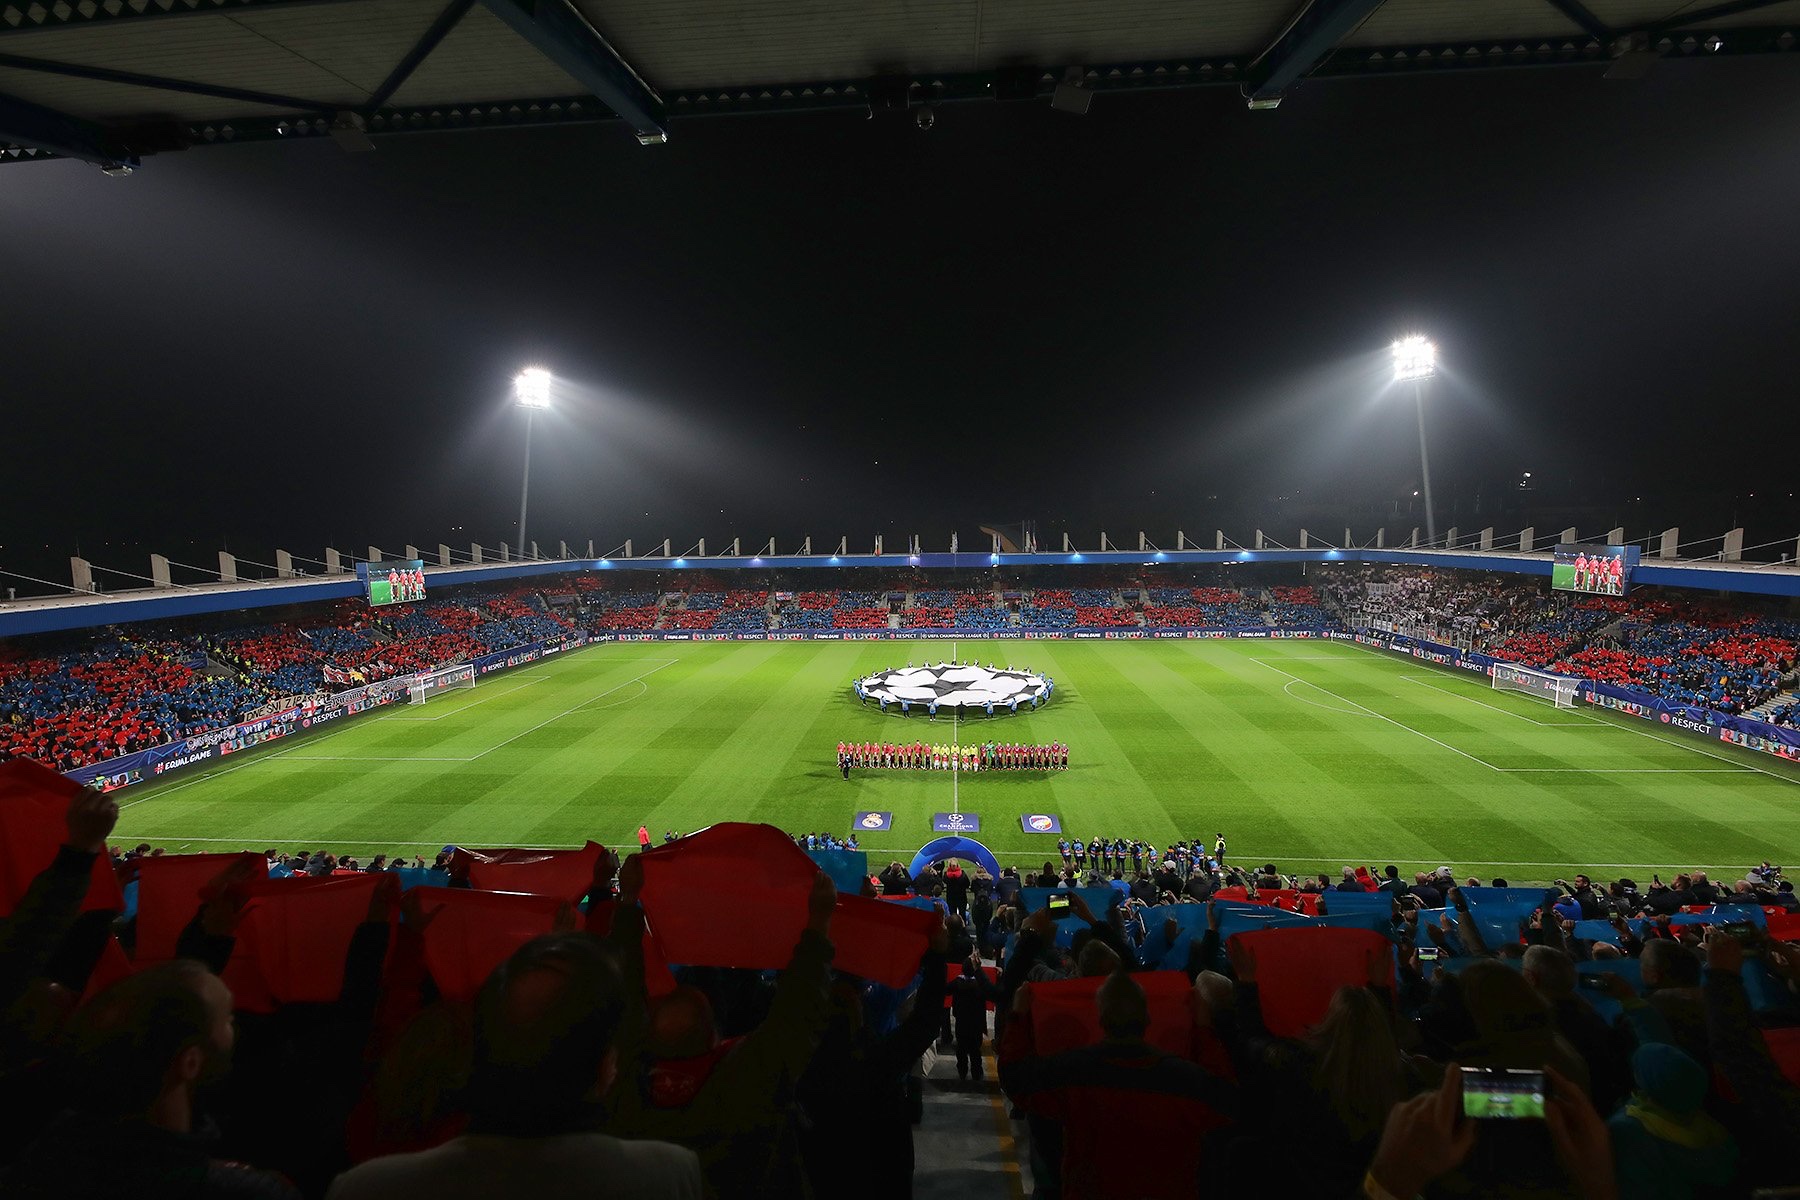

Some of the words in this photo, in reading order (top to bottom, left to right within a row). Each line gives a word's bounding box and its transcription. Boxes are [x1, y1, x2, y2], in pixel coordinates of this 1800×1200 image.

[594, 634, 615, 642] RESPECT
[487, 661, 506, 671] RESPECT
[1461, 661, 1483, 672] RESPECT
[312, 708, 342, 724] RESPECT
[1672, 716, 1712, 734] RESPECT
